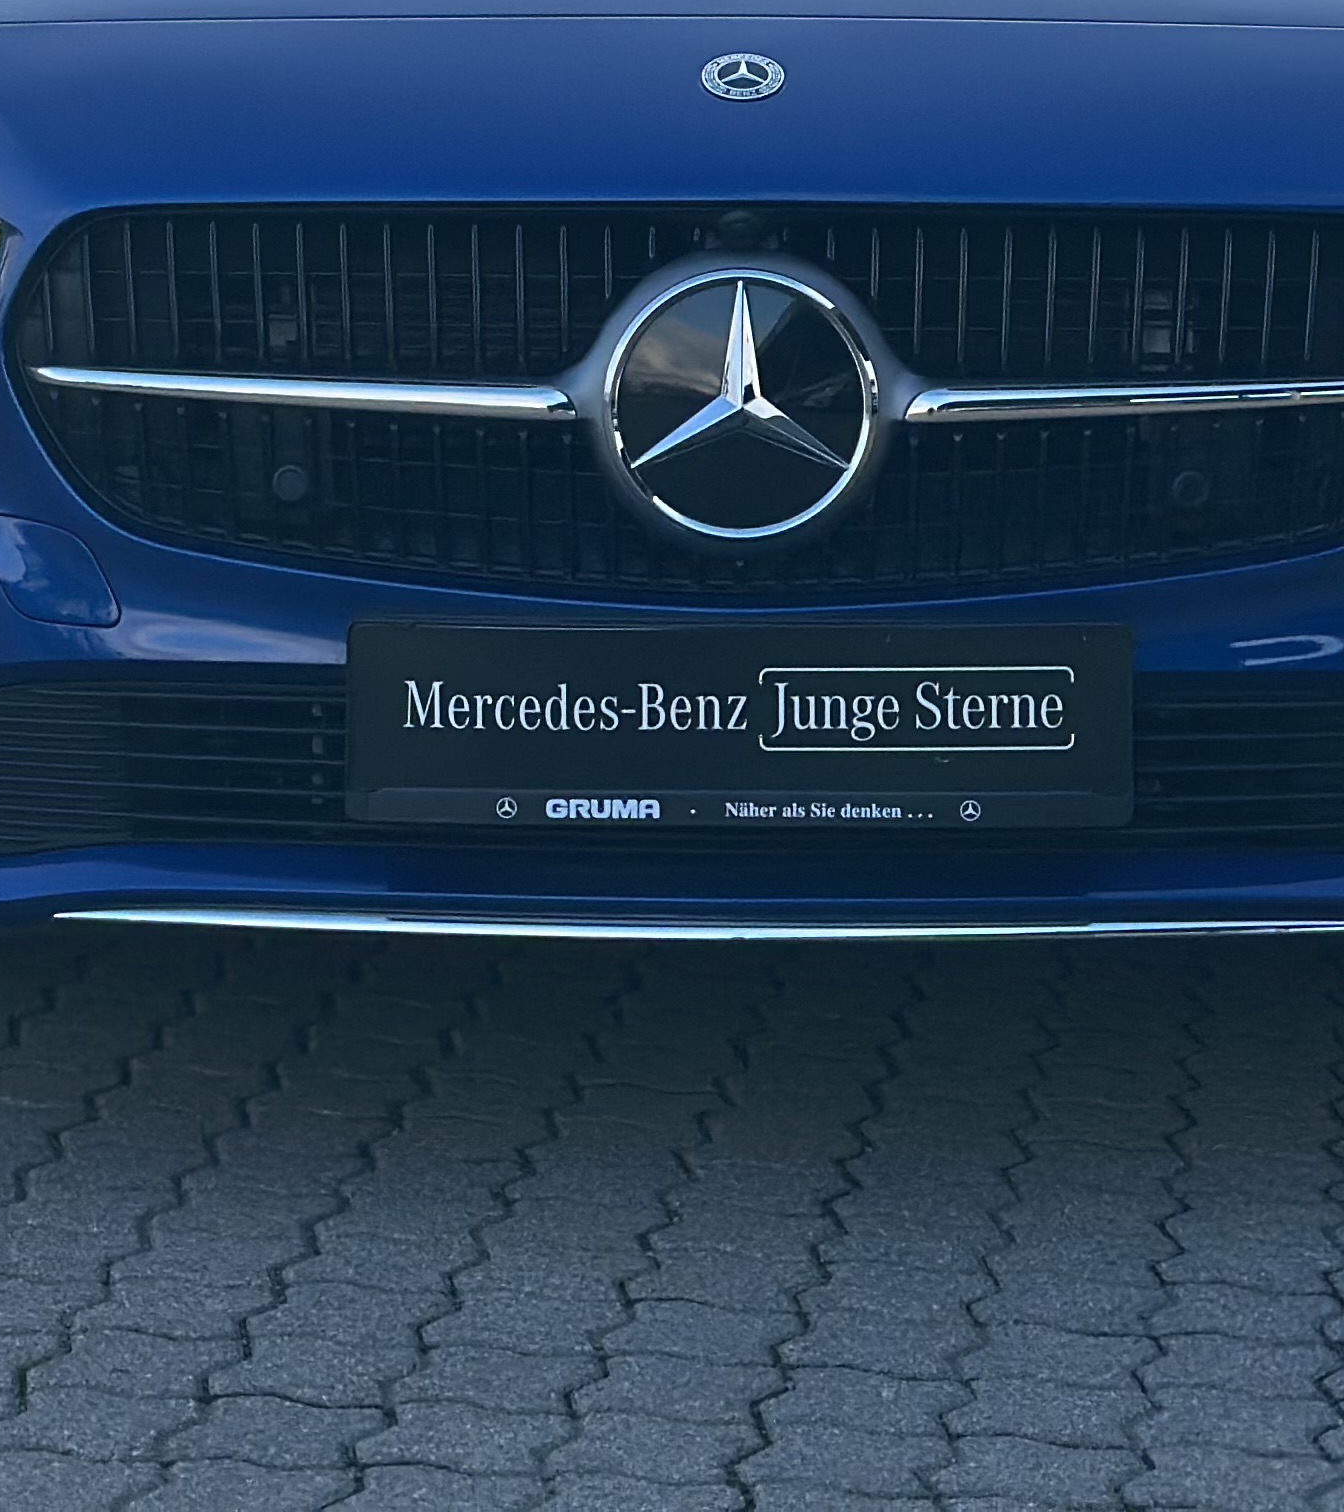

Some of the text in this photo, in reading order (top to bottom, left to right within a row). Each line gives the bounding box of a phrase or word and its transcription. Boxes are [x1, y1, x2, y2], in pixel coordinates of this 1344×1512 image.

[402, 680, 1063, 742] Mercedes-Benz Junge Sterne
[545, 798, 661, 820] GRUMA
[724, 801, 778, 819] Näher
[782, 801, 806, 819] als
[809, 802, 836, 819] Sie
[840, 802, 903, 819] denken
